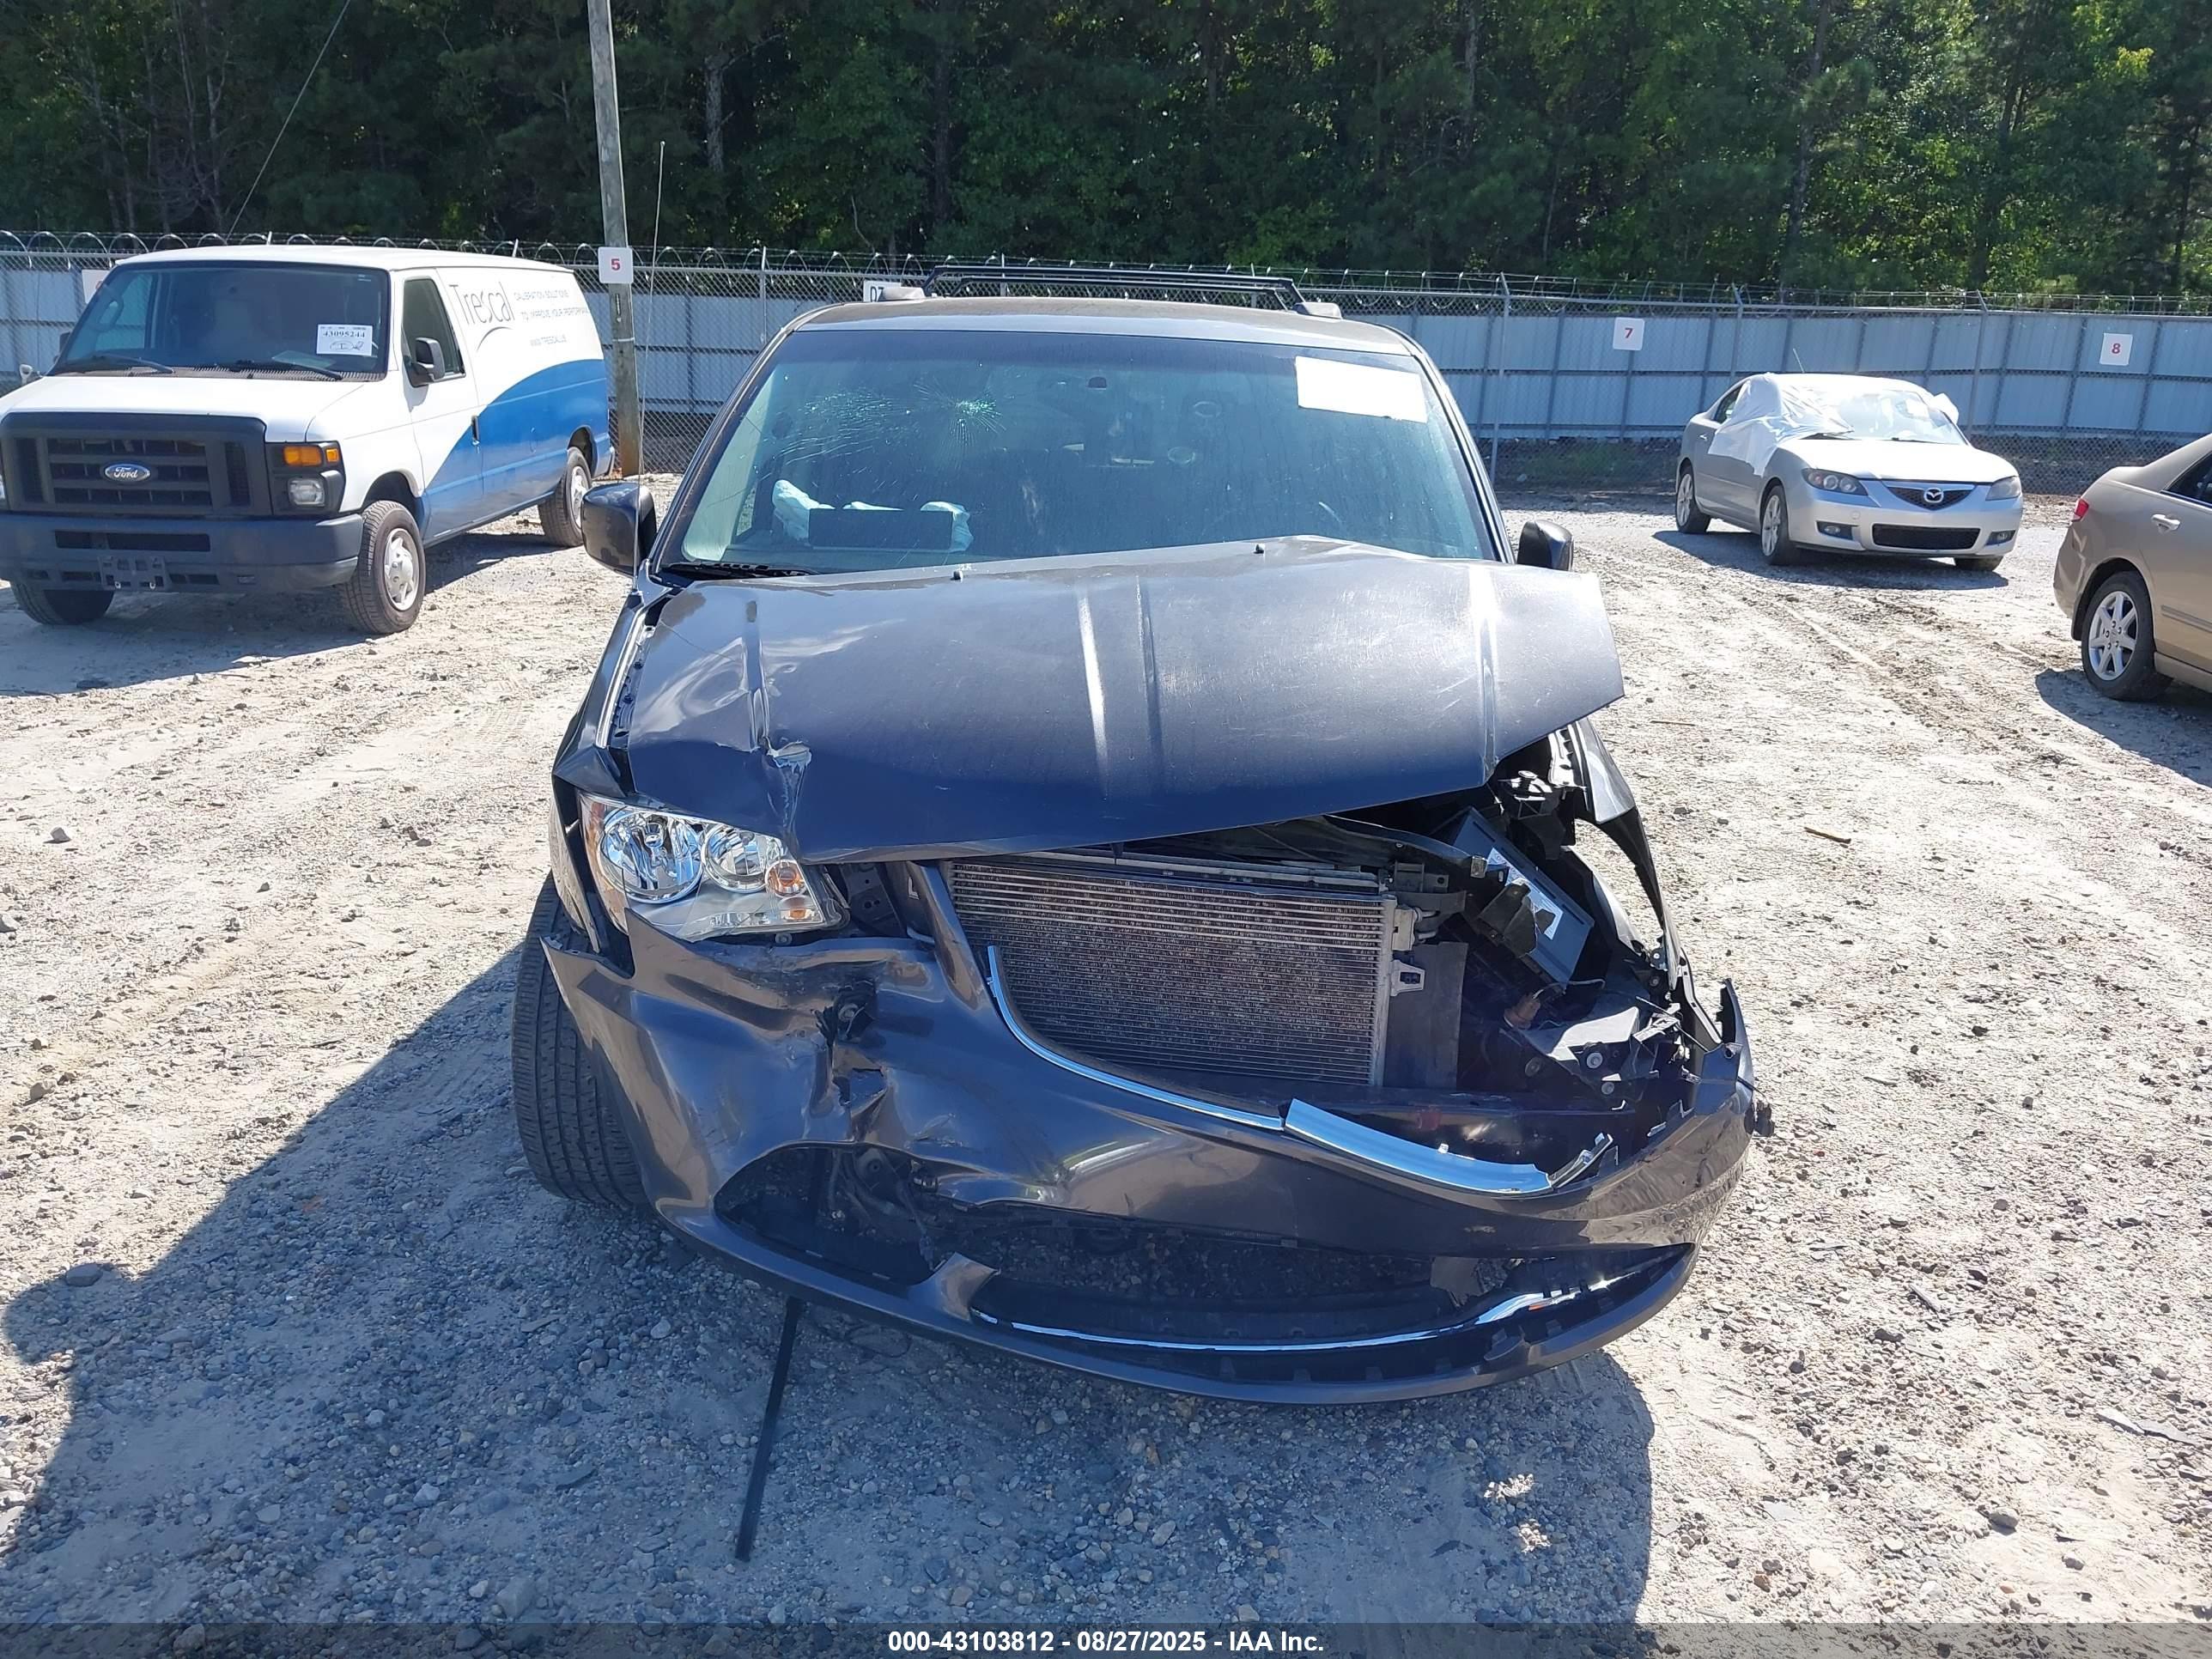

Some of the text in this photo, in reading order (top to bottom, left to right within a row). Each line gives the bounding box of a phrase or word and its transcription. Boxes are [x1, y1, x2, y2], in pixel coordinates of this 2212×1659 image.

[611, 258, 621, 271] 5
[449, 281, 515, 325] Trescal
[1625, 327, 1633, 338] 7
[2112, 343, 2121, 355] 8
[113, 466, 138, 478] Ford
